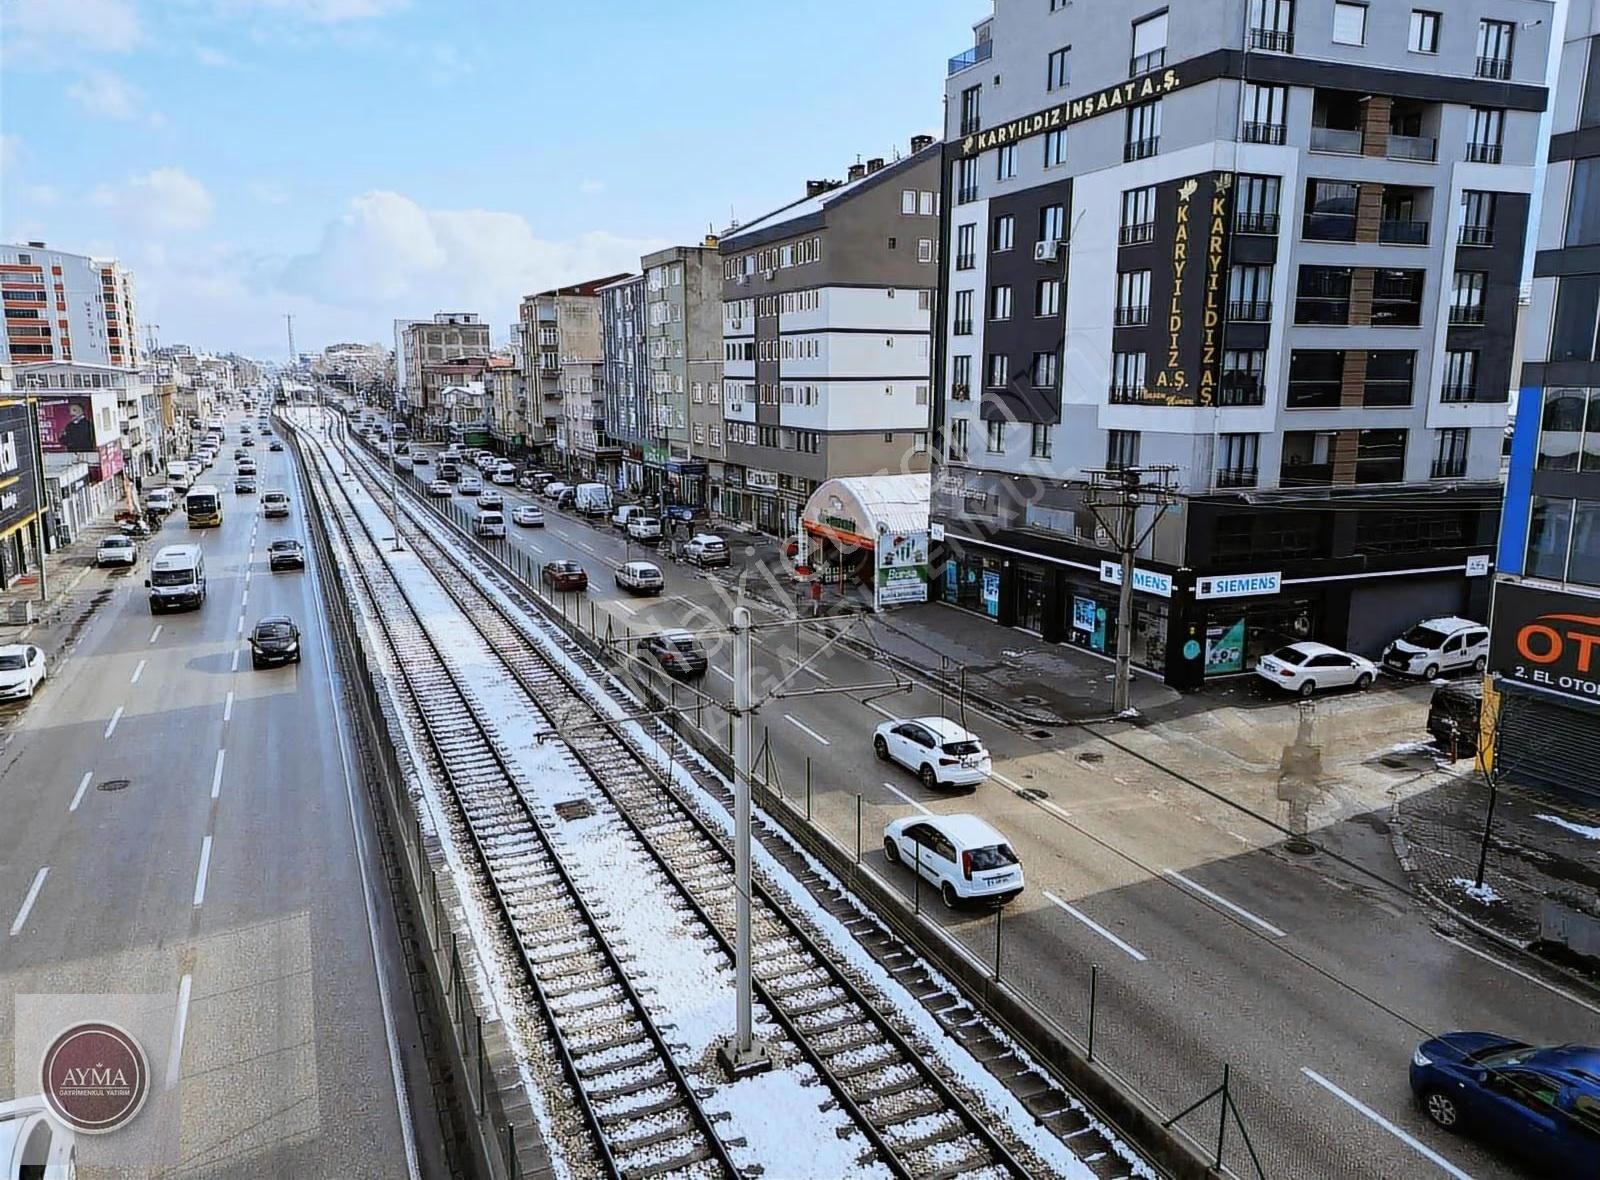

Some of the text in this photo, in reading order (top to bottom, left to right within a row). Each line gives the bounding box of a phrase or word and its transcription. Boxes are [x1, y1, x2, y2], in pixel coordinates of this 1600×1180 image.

[977, 109, 1061, 149] KARYILDIZ
[1065, 84, 1135, 121] İNŞAAT
[1168, 205, 1188, 367] KARYILDIZ
[1203, 198, 1225, 363] KARYILDIZ
[1117, 569, 1168, 591] SMENS
[1216, 576, 1276, 593] SIEMENS
[1514, 666, 1600, 694] 2. EL OTO
